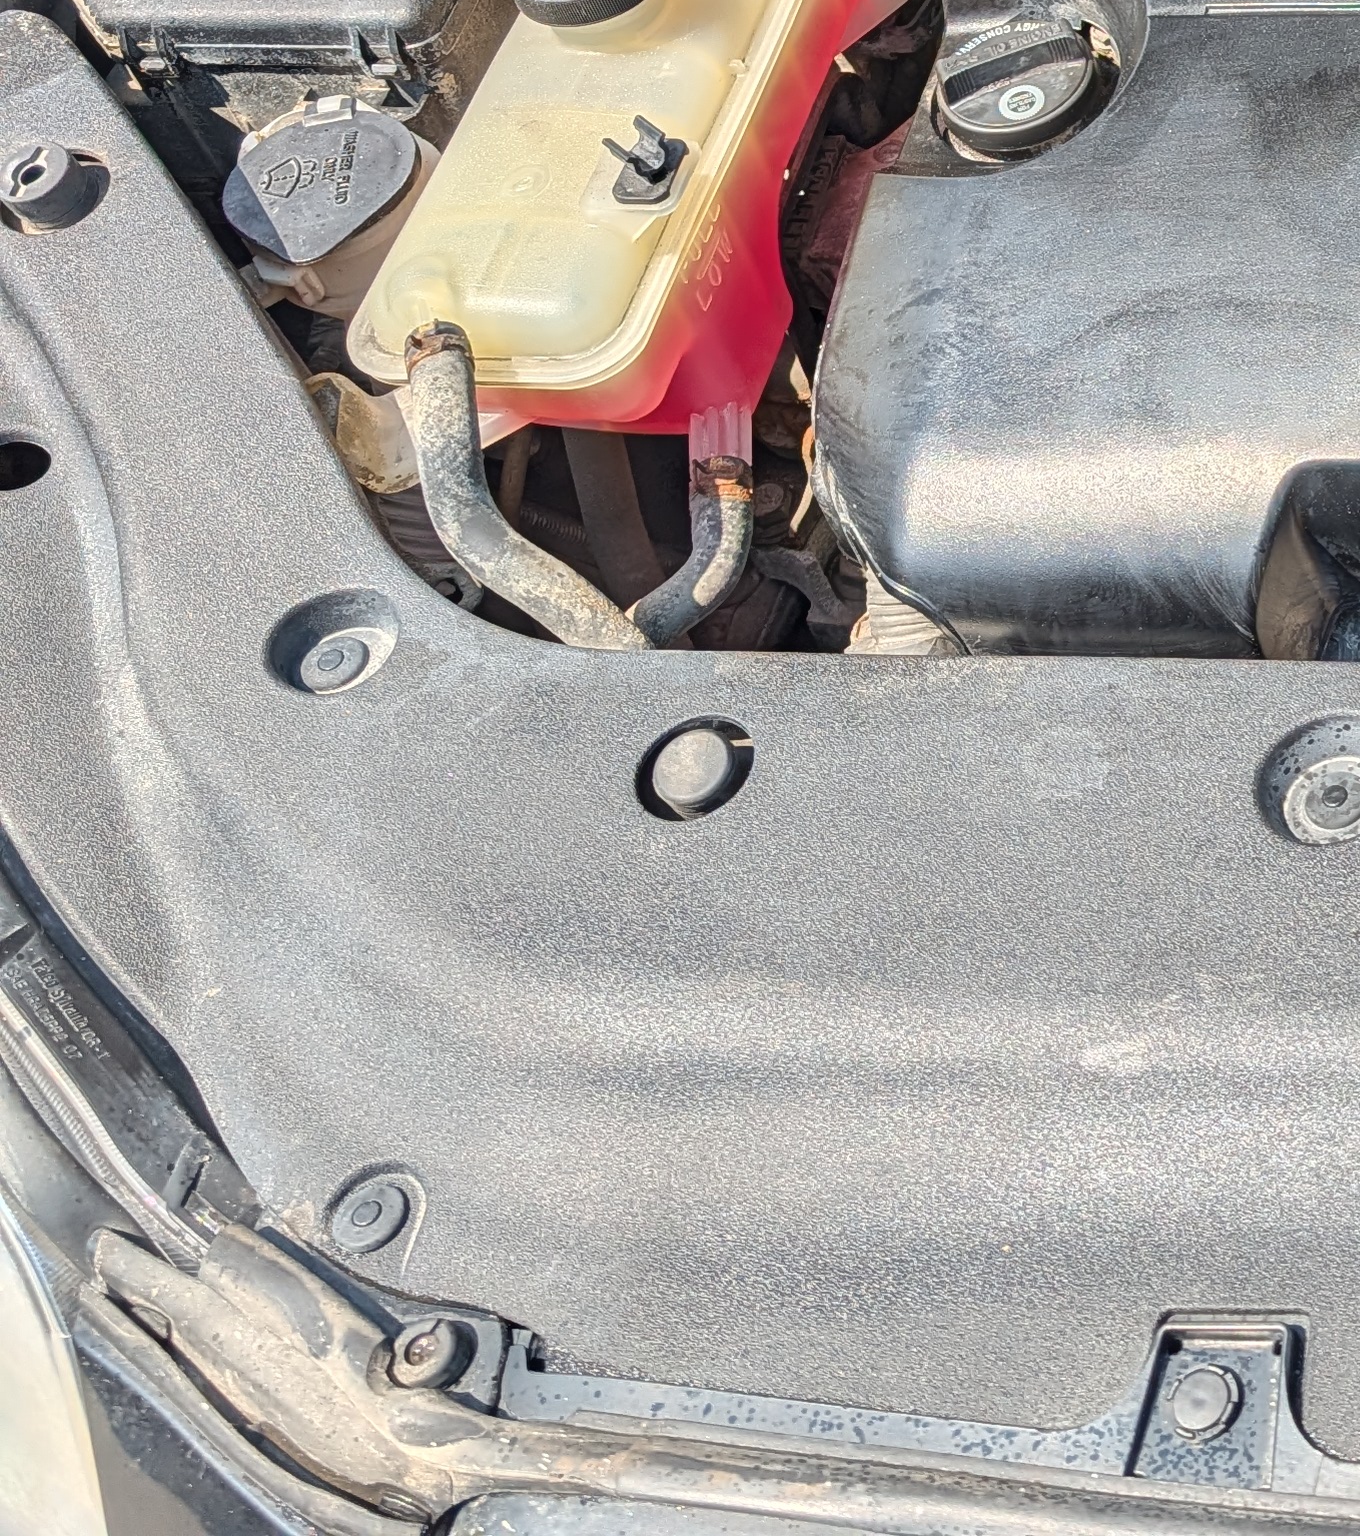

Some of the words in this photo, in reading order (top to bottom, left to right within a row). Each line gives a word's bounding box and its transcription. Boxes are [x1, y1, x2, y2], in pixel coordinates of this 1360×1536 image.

[955, 24, 1012, 56] CONSERV
[983, 42, 1008, 56] OIL
[1009, 23, 1064, 50] ENGINE
[31, 958, 59, 990] Valeo
[47, 989, 89, 1032] Sylvania
